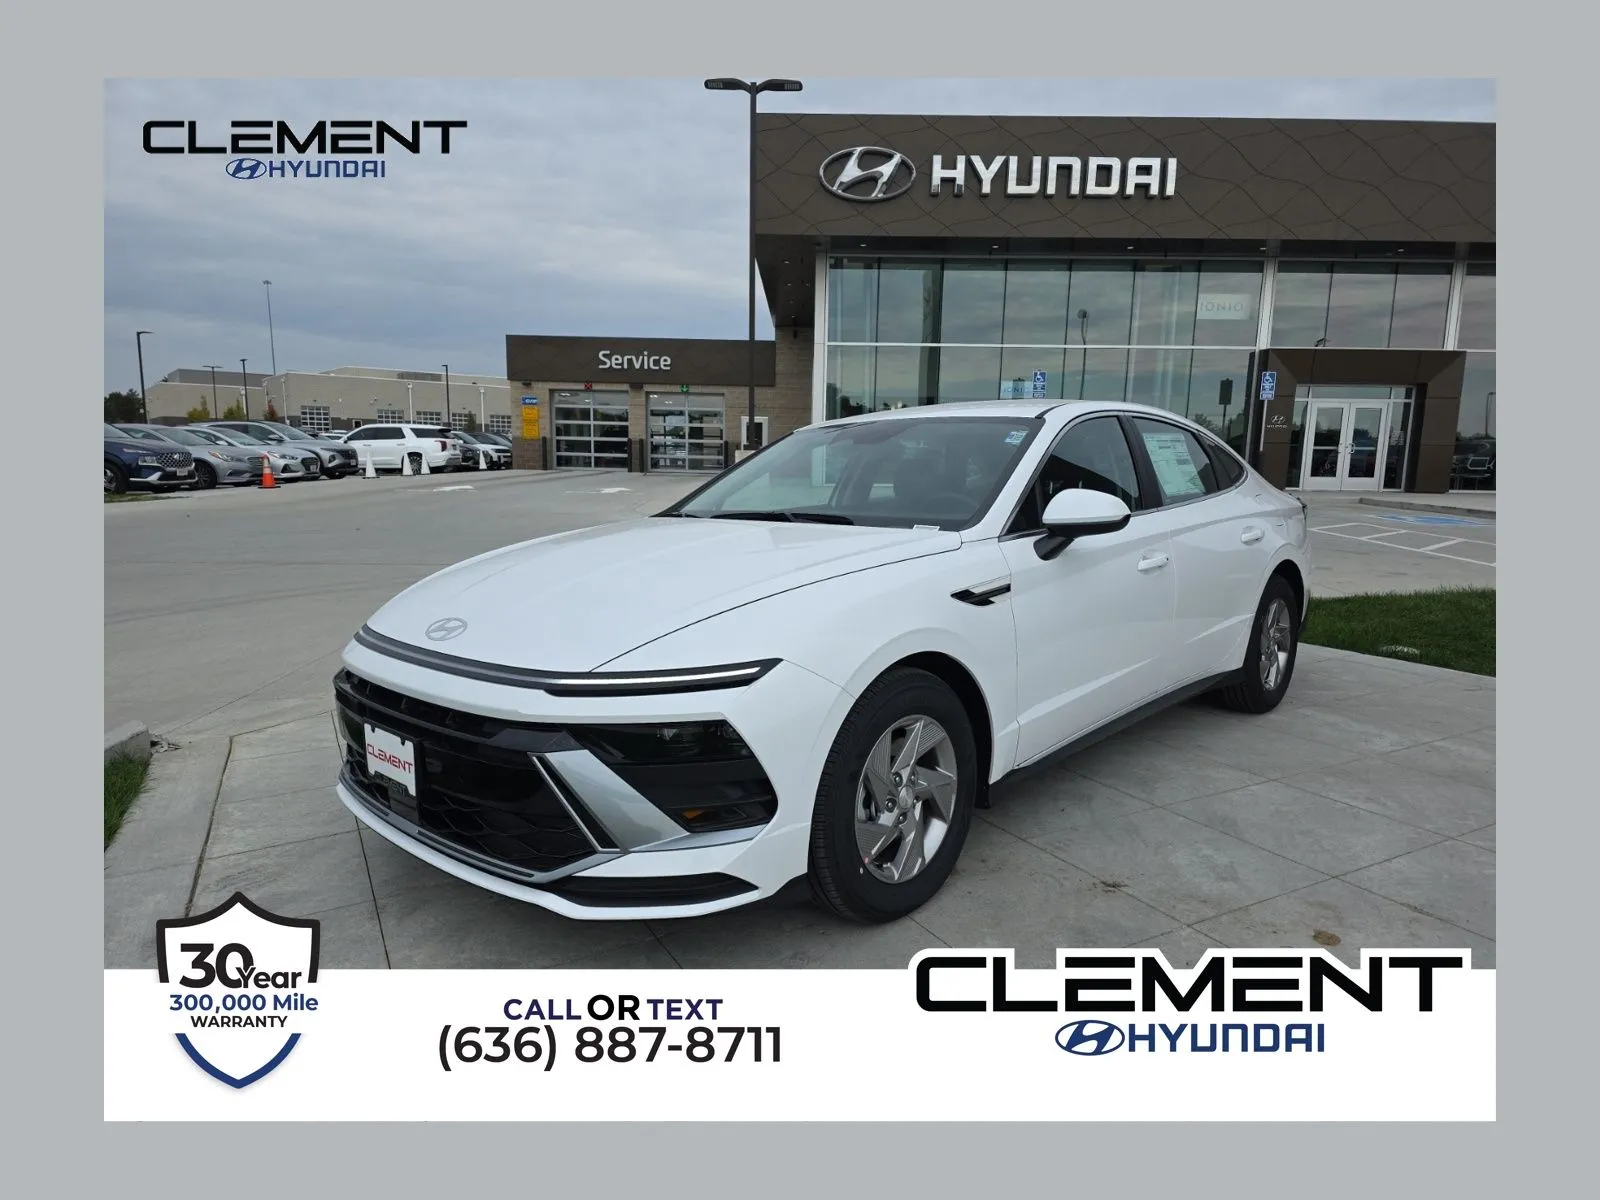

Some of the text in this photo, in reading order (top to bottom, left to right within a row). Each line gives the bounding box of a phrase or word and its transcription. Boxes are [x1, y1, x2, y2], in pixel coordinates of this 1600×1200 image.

[929, 154, 1178, 197] HYUNDAI
[598, 350, 672, 370] Service
[366, 743, 413, 774] CLEMENT
